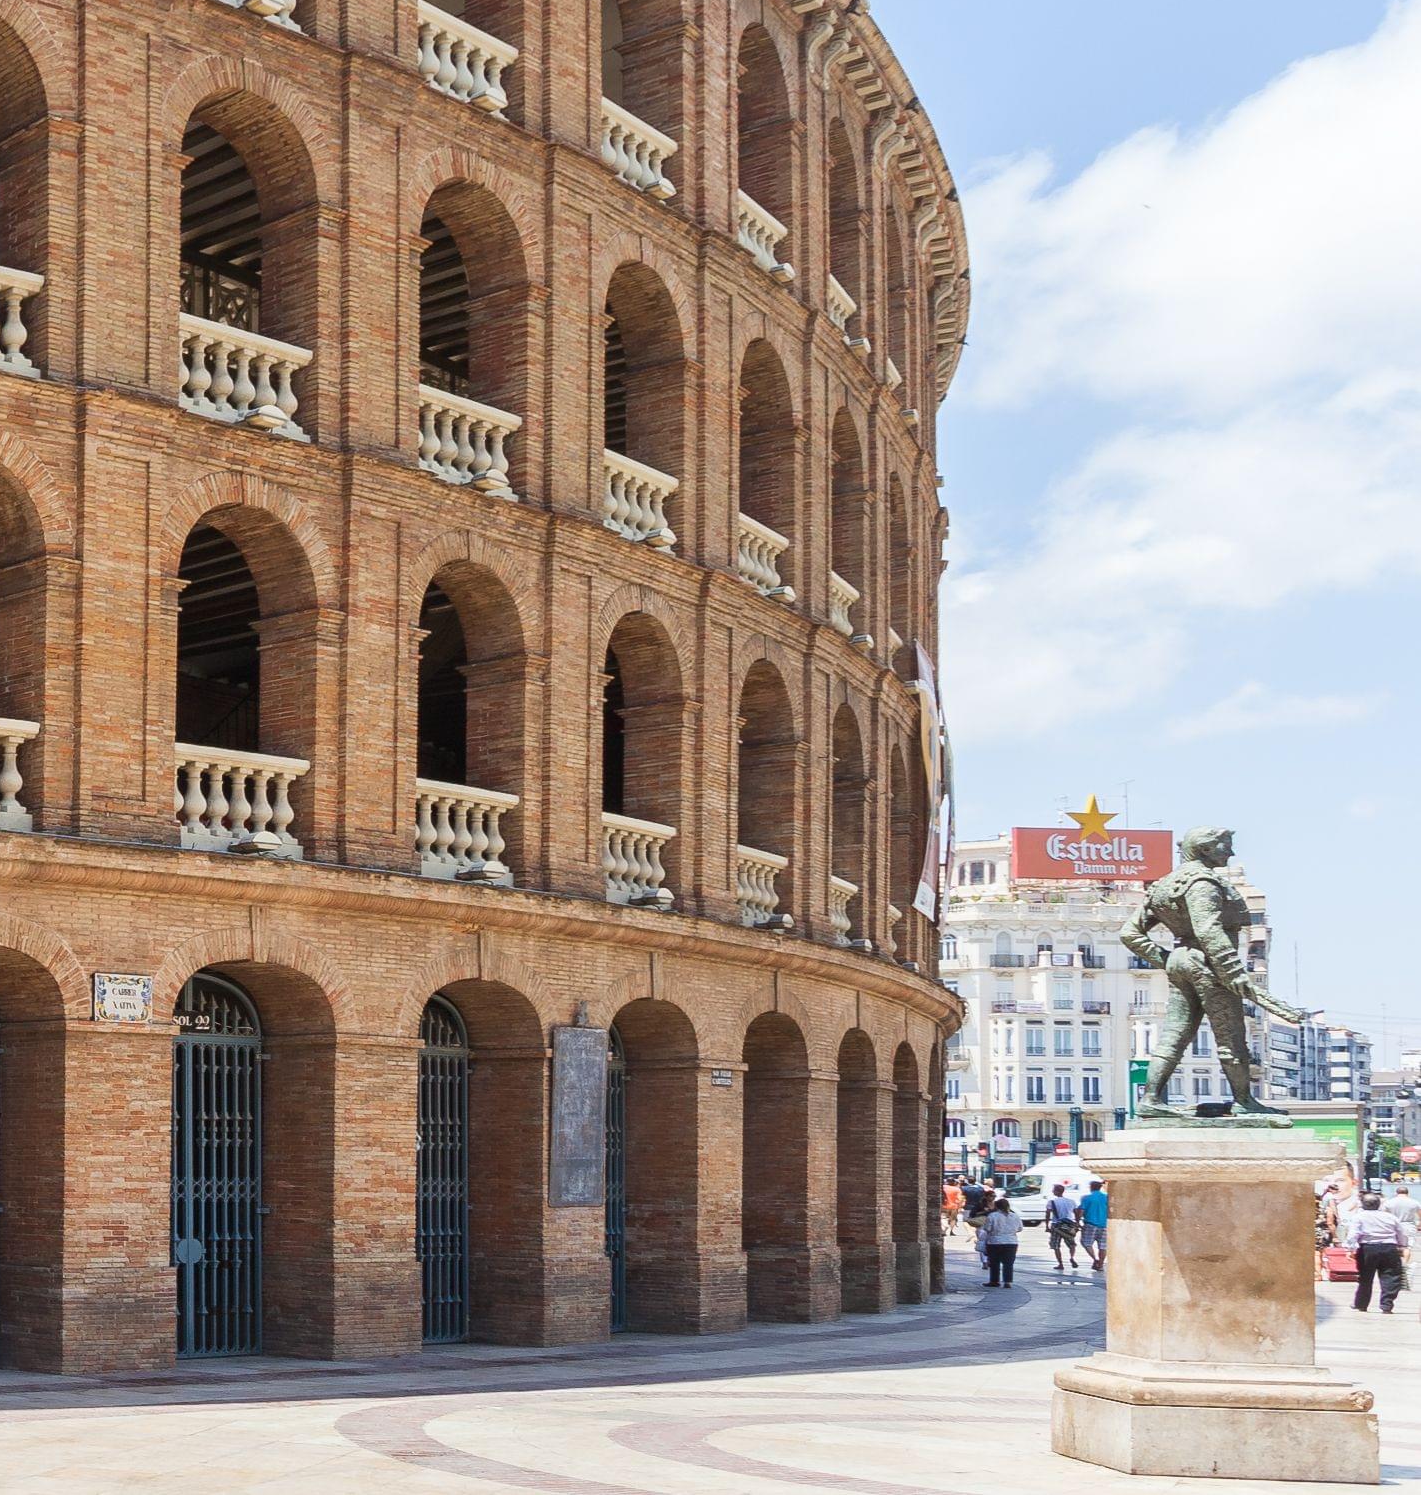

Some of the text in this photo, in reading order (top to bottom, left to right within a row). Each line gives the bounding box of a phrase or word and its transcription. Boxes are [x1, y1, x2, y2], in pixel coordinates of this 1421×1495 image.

[1046, 833, 1144, 862] Estrella
[1074, 861, 1117, 875] Damm
[172, 1015, 193, 1026] SOL
